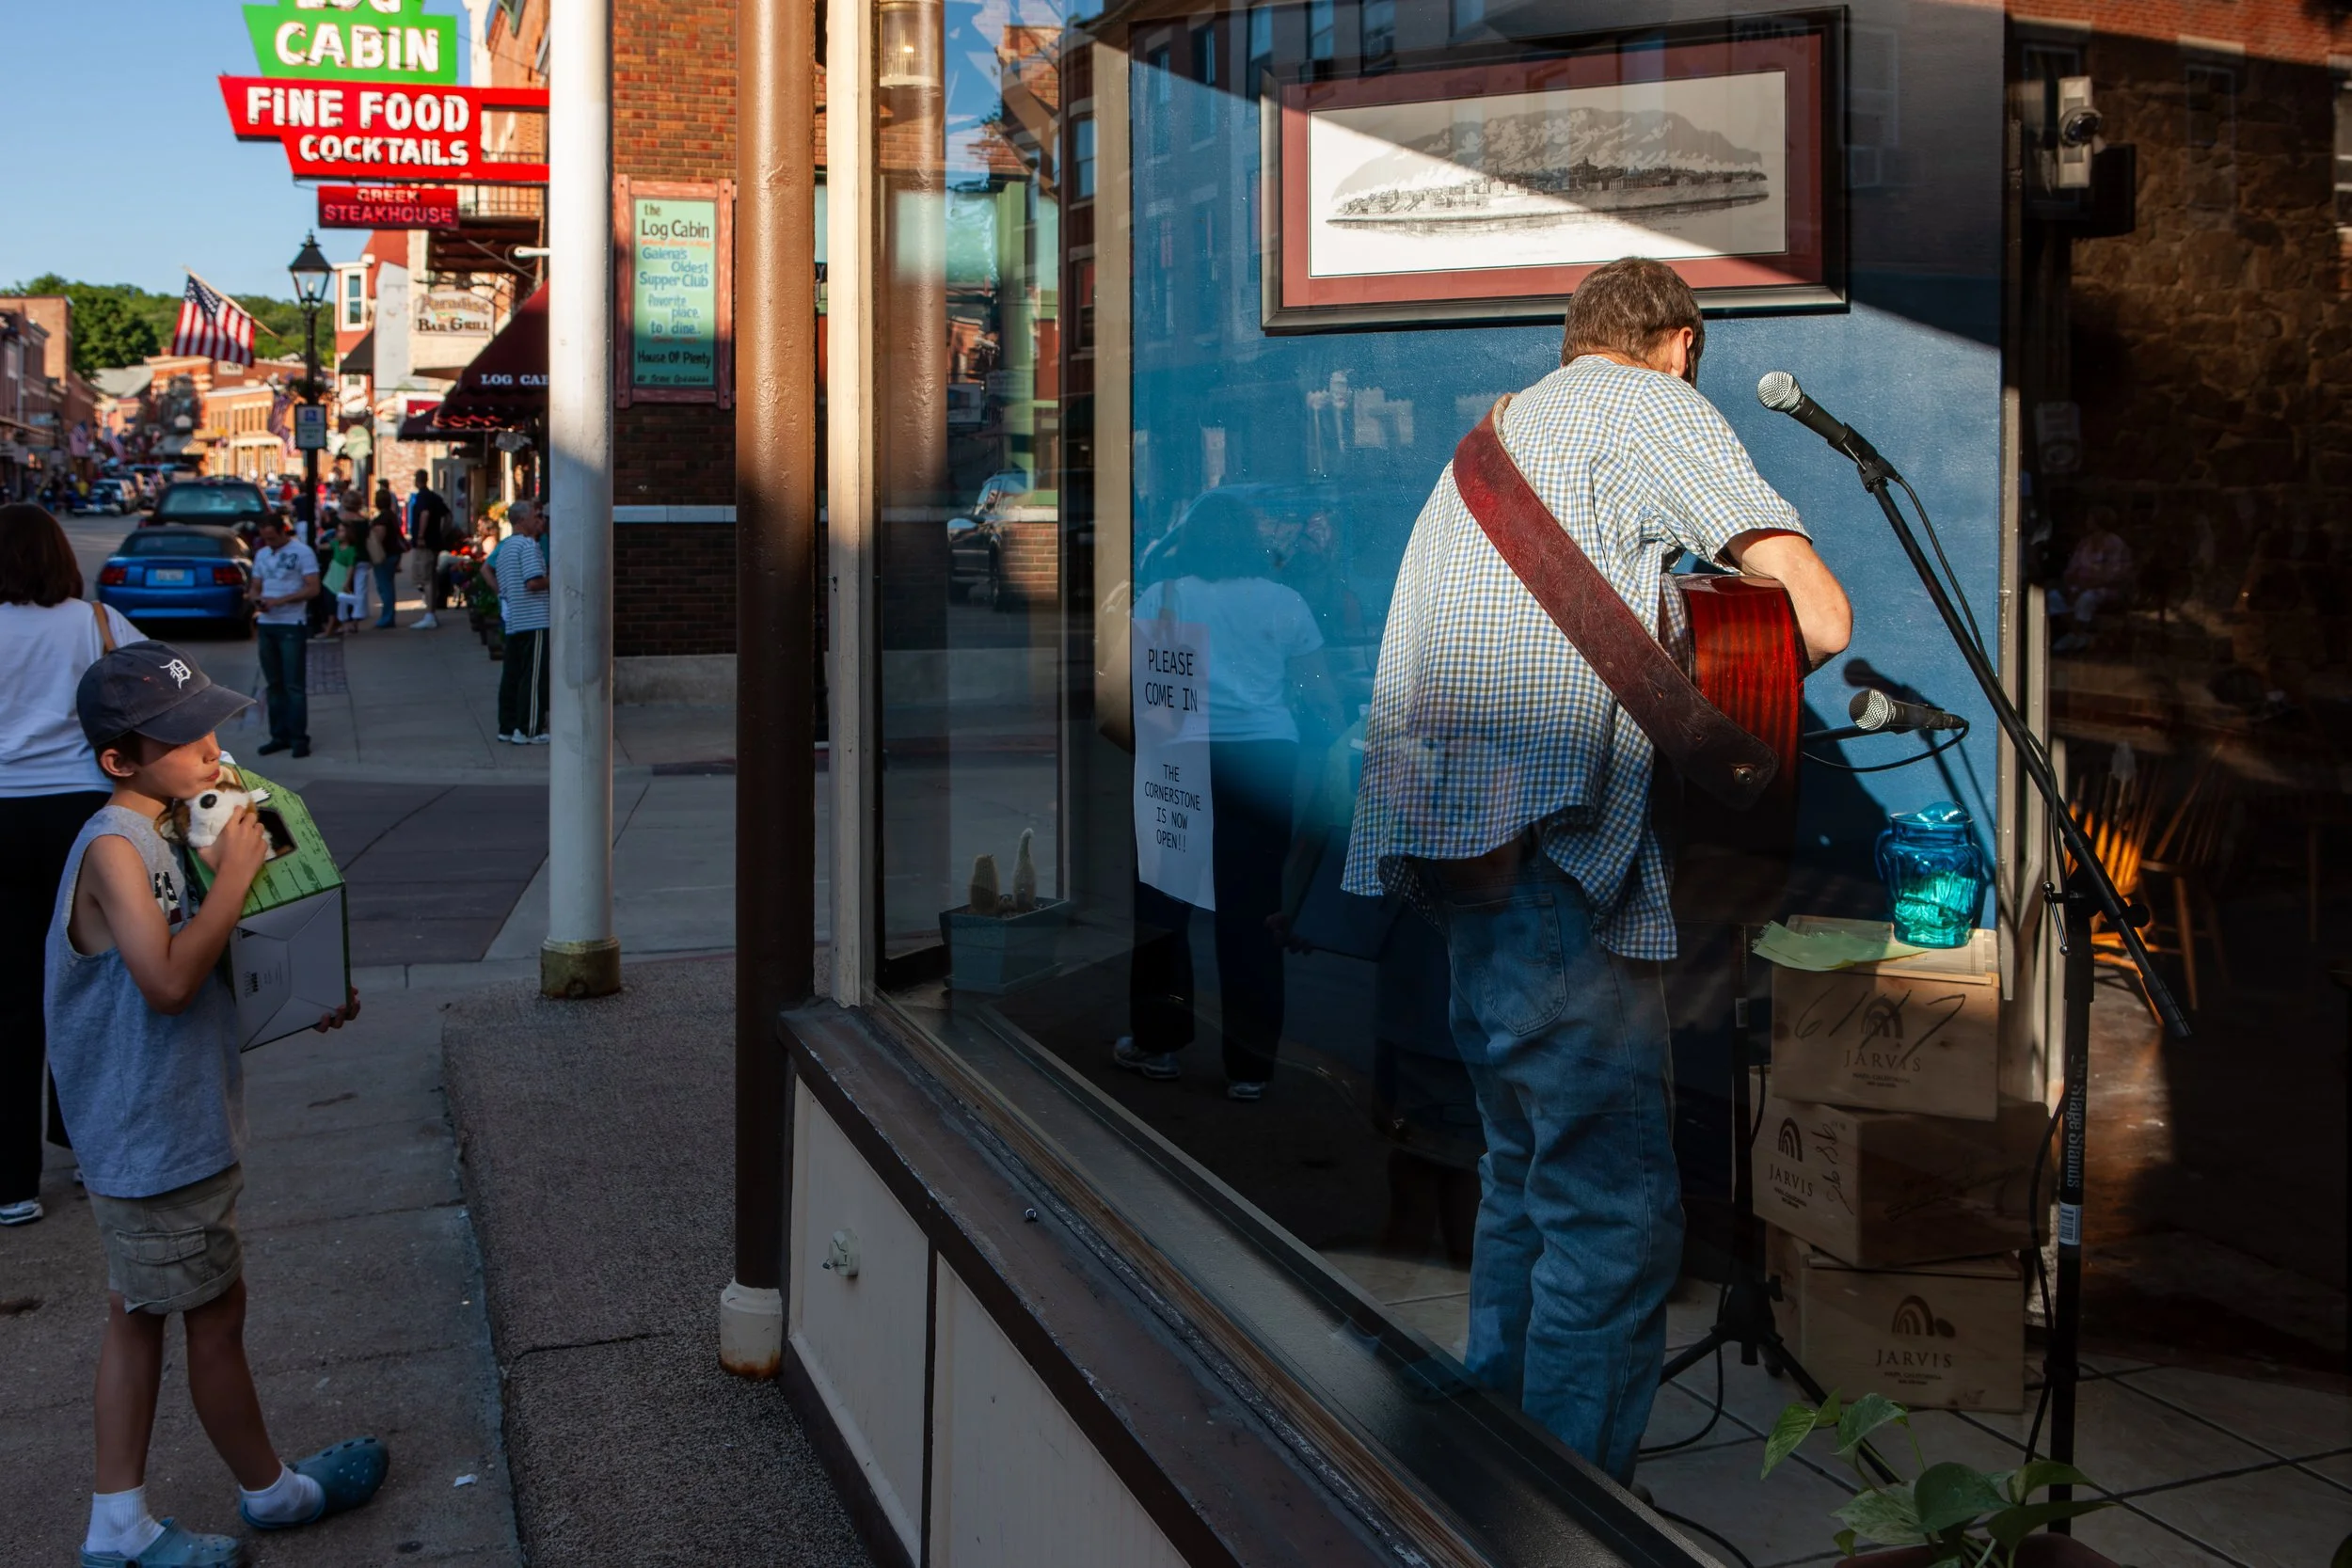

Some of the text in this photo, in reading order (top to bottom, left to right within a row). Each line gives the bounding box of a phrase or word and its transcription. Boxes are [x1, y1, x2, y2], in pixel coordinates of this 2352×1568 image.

[275, 21, 439, 71] CABIN
[246, 86, 469, 133] FINE FOOD
[298, 134, 469, 166] COCKTAILS
[323, 204, 453, 223] STEAKHOUSE
[642, 219, 709, 240] Log Cabin
[671, 261, 708, 274] Oldest
[640, 271, 709, 291] Supper Club
[650, 320, 663, 334] to
[481, 373, 514, 386] LOG
[1148, 649, 1194, 677] PLEASE
[1145, 682, 1198, 712] COME IN
[1163, 764, 1180, 783] THE
[1145, 782, 1200, 811] CORNERSTONE
[1156, 807, 1188, 831] IS NOW
[1156, 829, 1186, 853] OPEN!!
[1843, 1051, 1922, 1072] JARVIS
[2066, 1132, 2085, 1189] Stands
[1769, 1164, 1814, 1197] JARVIS
[1875, 1349, 1952, 1369] JARVIS
